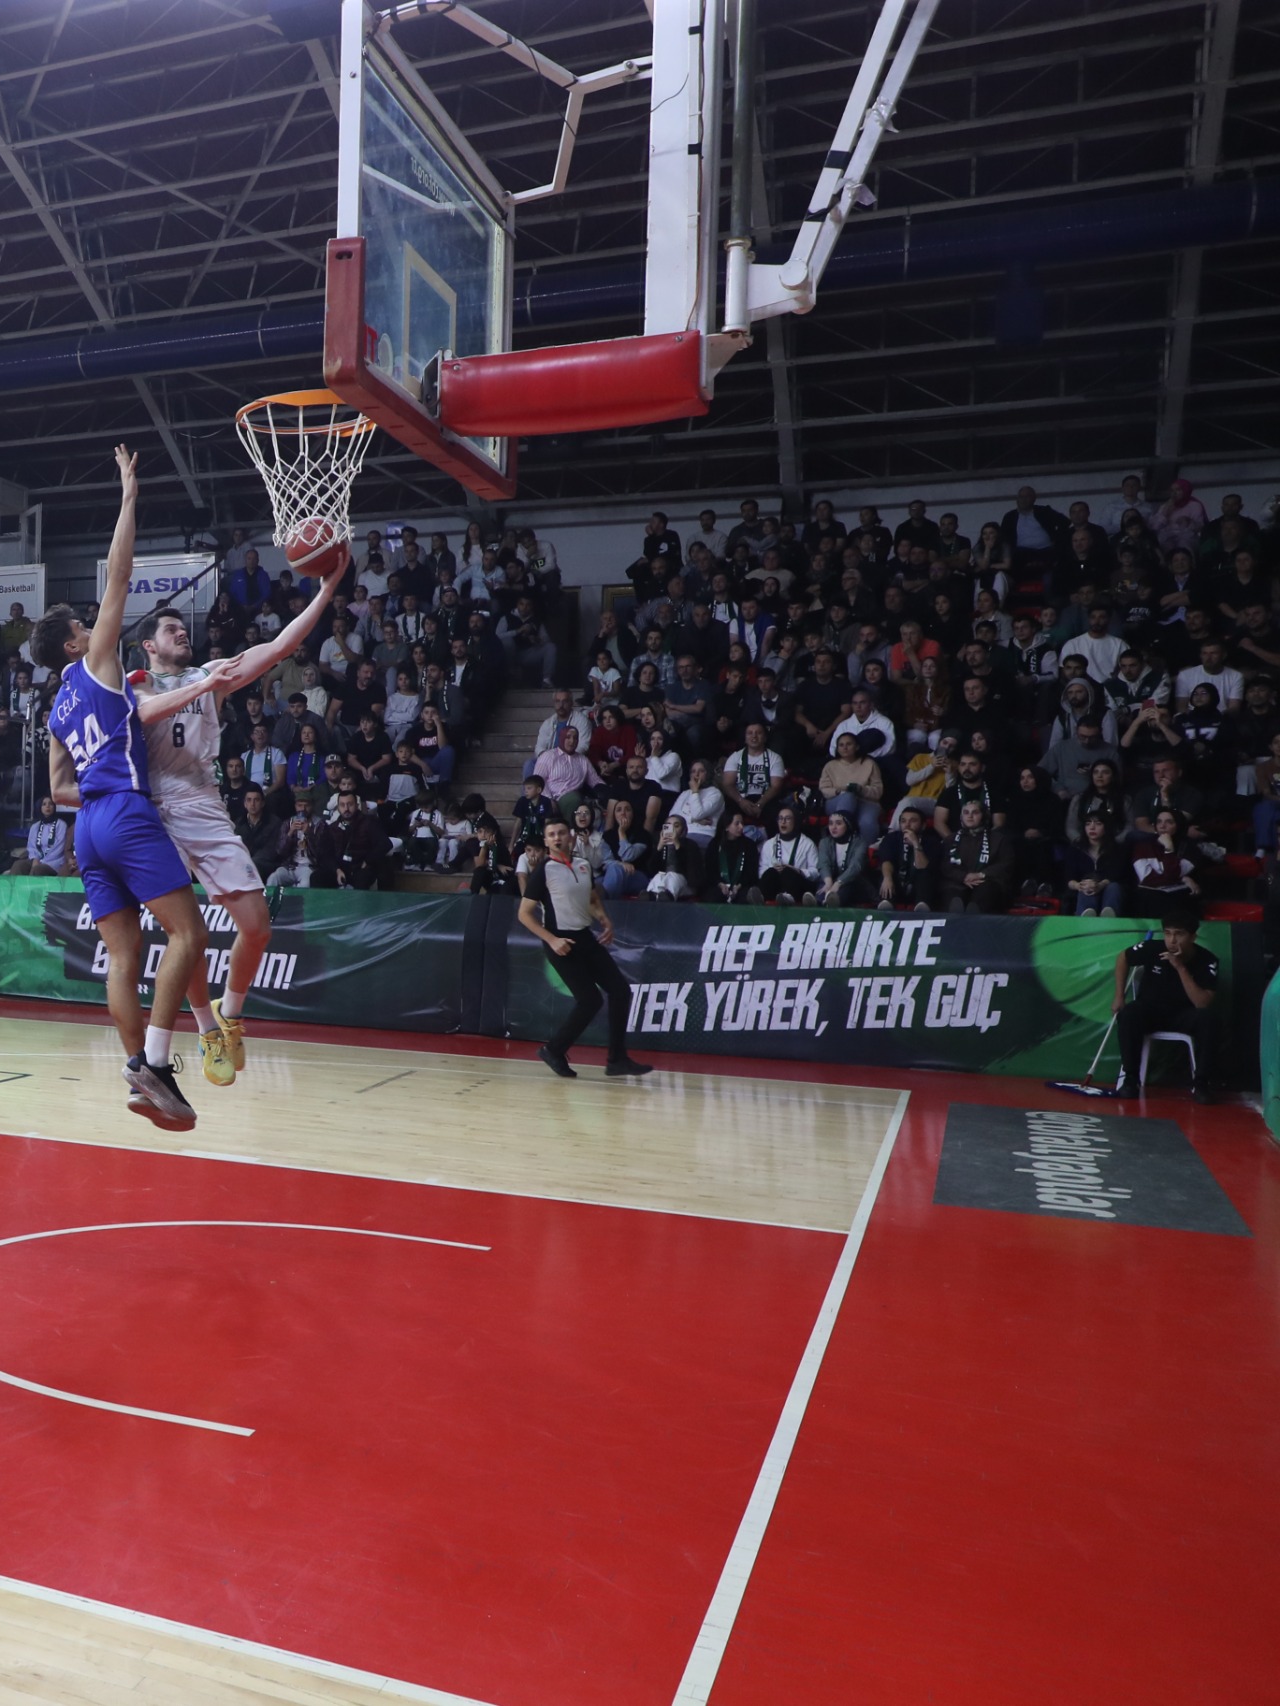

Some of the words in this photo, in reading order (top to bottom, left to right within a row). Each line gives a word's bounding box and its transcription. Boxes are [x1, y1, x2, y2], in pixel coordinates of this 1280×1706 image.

[0, 583, 36, 594] Basketball
[57, 689, 82, 725] ÇELİK
[65, 712, 110, 772] 54
[172, 722, 186, 748] 8
[699, 924, 775, 973] HEP
[777, 914, 946, 971] BİRLİKTE
[626, 982, 693, 1033] TEK
[703, 973, 829, 1037] YÜREK,
[846, 975, 922, 1030] TEK
[924, 966, 1010, 1034] GÜÇ
